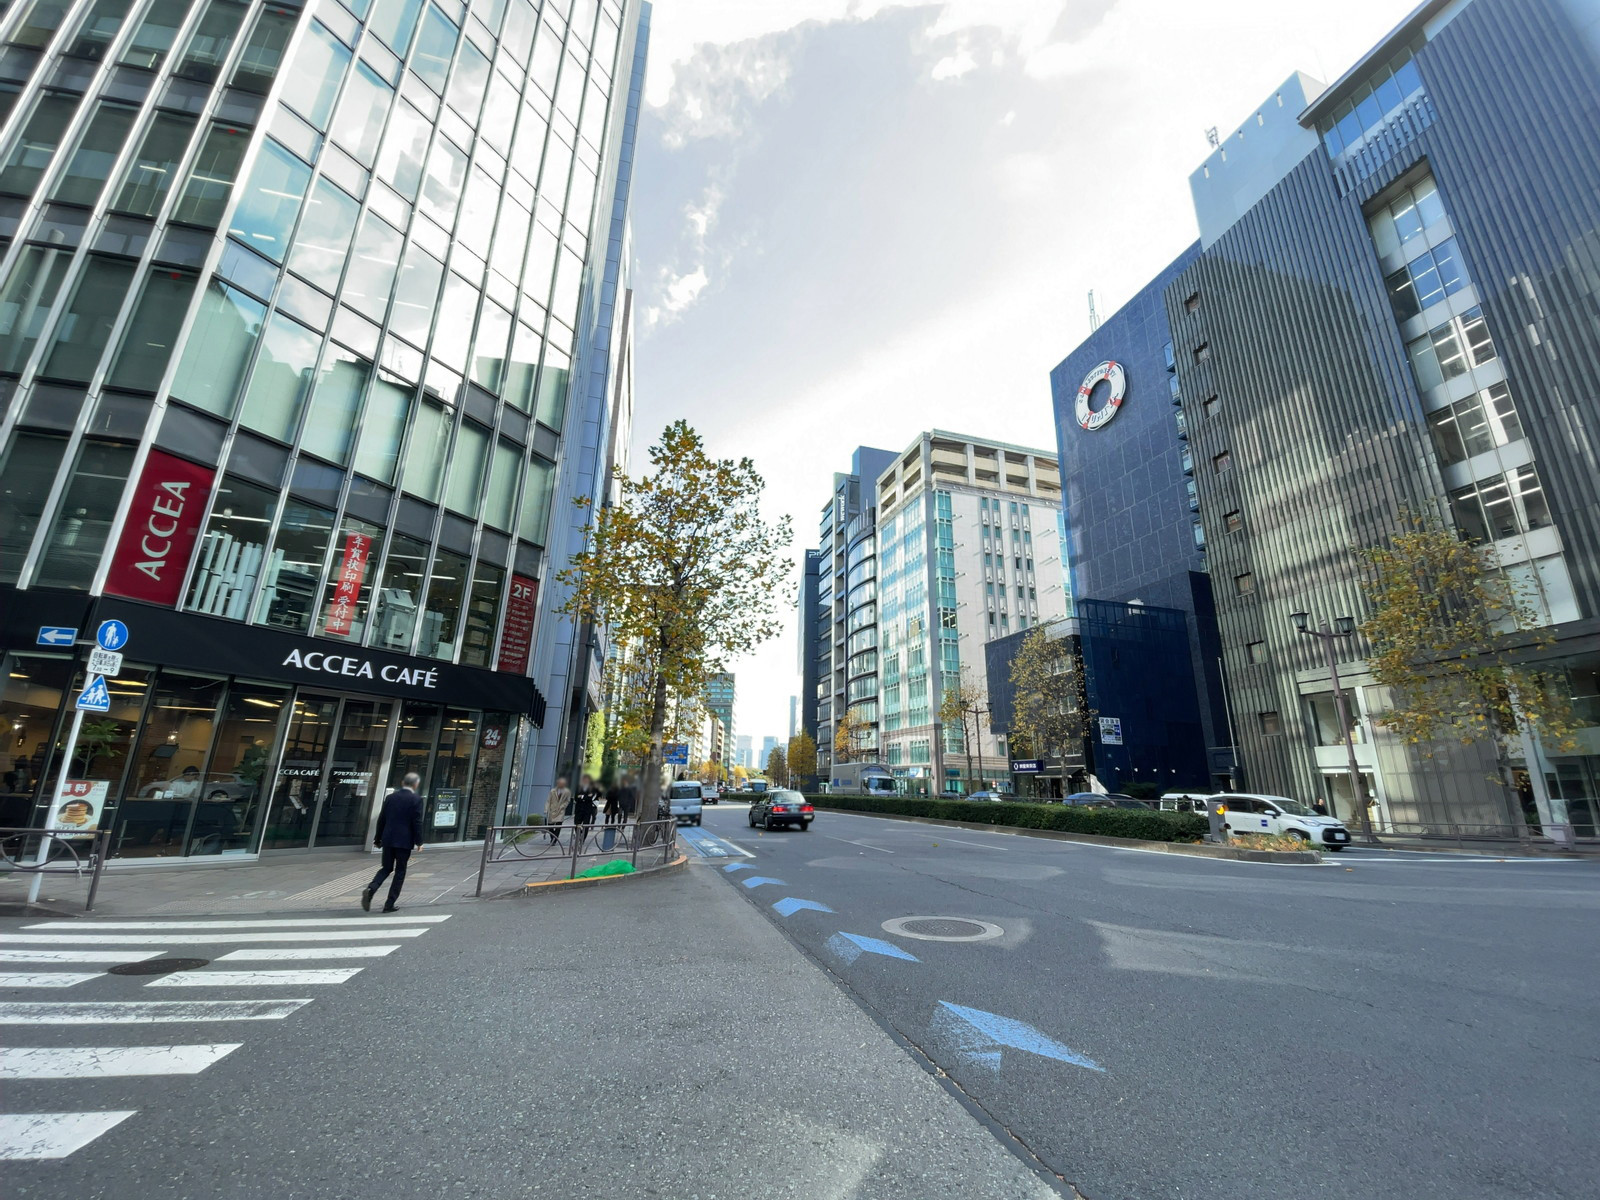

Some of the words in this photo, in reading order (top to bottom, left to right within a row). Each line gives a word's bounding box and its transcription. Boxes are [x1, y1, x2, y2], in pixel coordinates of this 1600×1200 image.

[134, 481, 191, 581] ACCEA
[513, 583, 532, 600] 2F
[282, 648, 374, 680] ACCEA
[380, 667, 439, 689] CAFÉ
[278, 768, 299, 776] CCEA
[300, 768, 320, 777] CAFÉ
